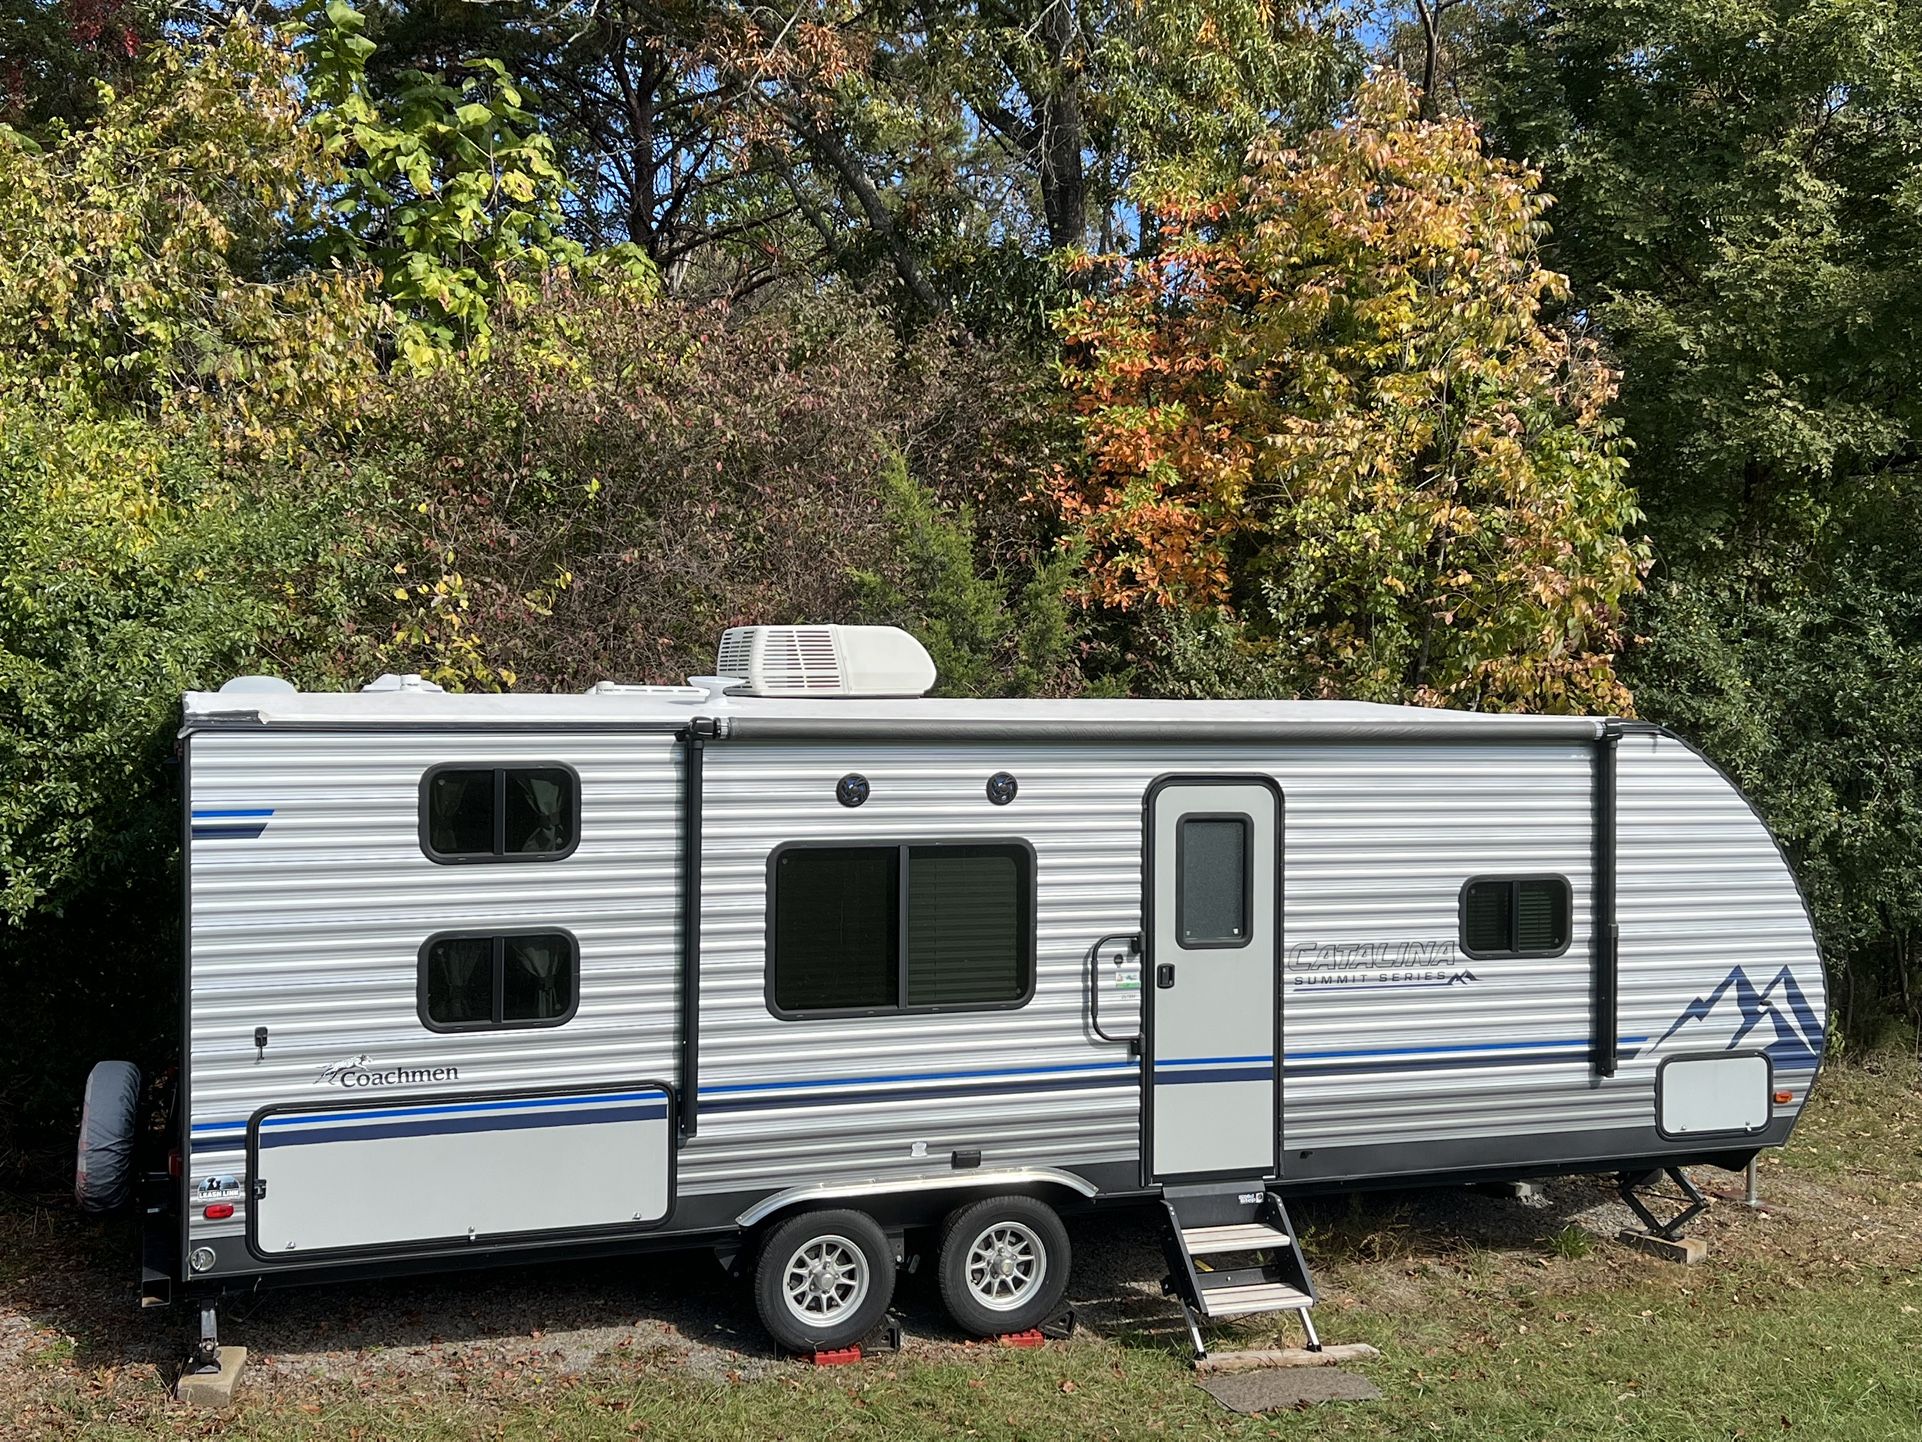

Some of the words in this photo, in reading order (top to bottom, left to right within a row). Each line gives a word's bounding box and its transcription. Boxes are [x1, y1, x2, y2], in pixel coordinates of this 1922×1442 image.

[1288, 941, 1455, 971] CATALINA
[1294, 974, 1368, 985] SUMMIT
[1379, 971, 1446, 982] SERIES
[340, 1067, 459, 1088] Coachmen
